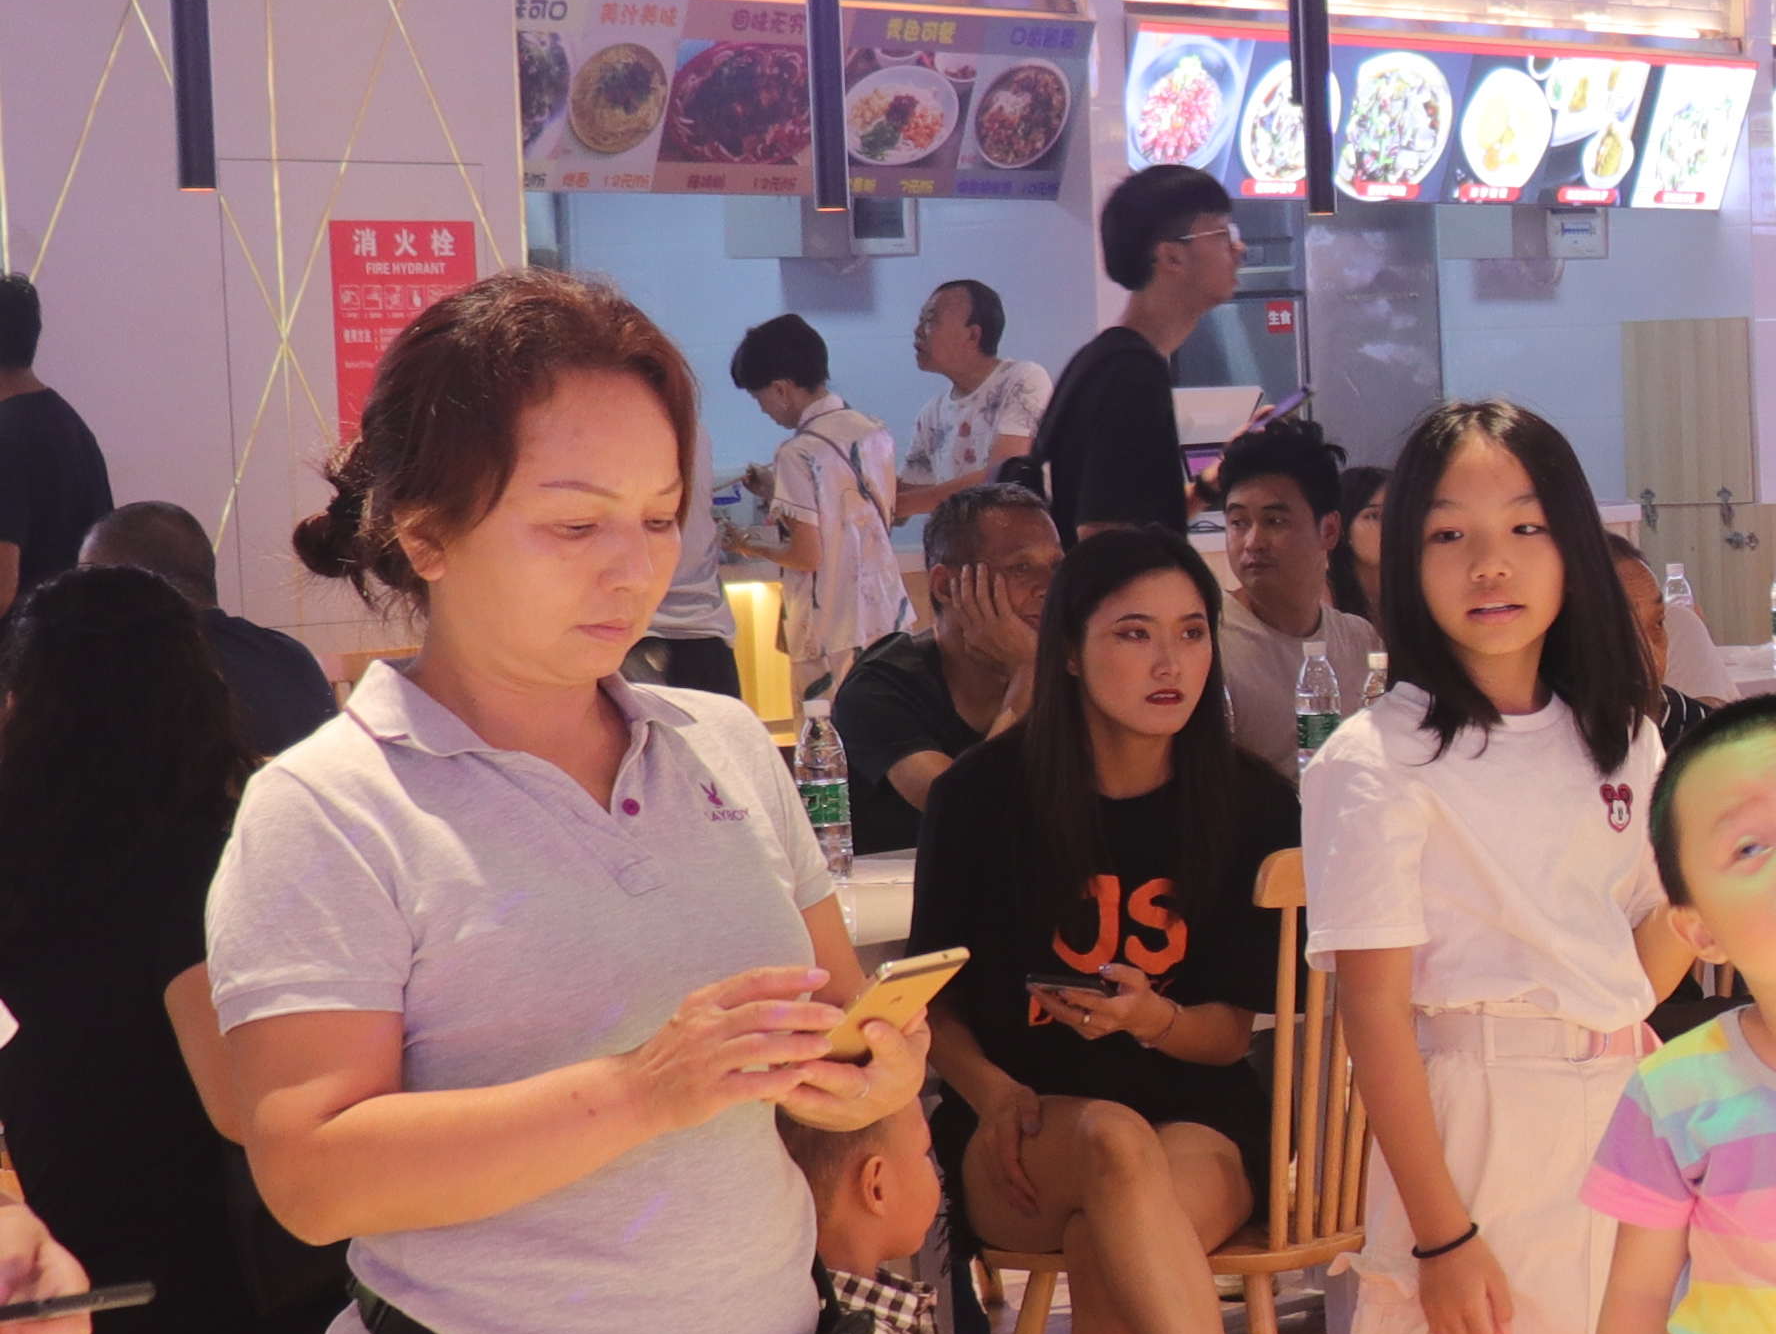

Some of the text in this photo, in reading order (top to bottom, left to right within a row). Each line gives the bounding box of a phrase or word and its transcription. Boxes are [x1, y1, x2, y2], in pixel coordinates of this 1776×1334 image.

[353, 227, 456, 258] 消火栓
[365, 261, 446, 275] FIRE HYDRANT
[1267, 310, 1292, 326] 生食
[1051, 874, 1189, 975] JS
